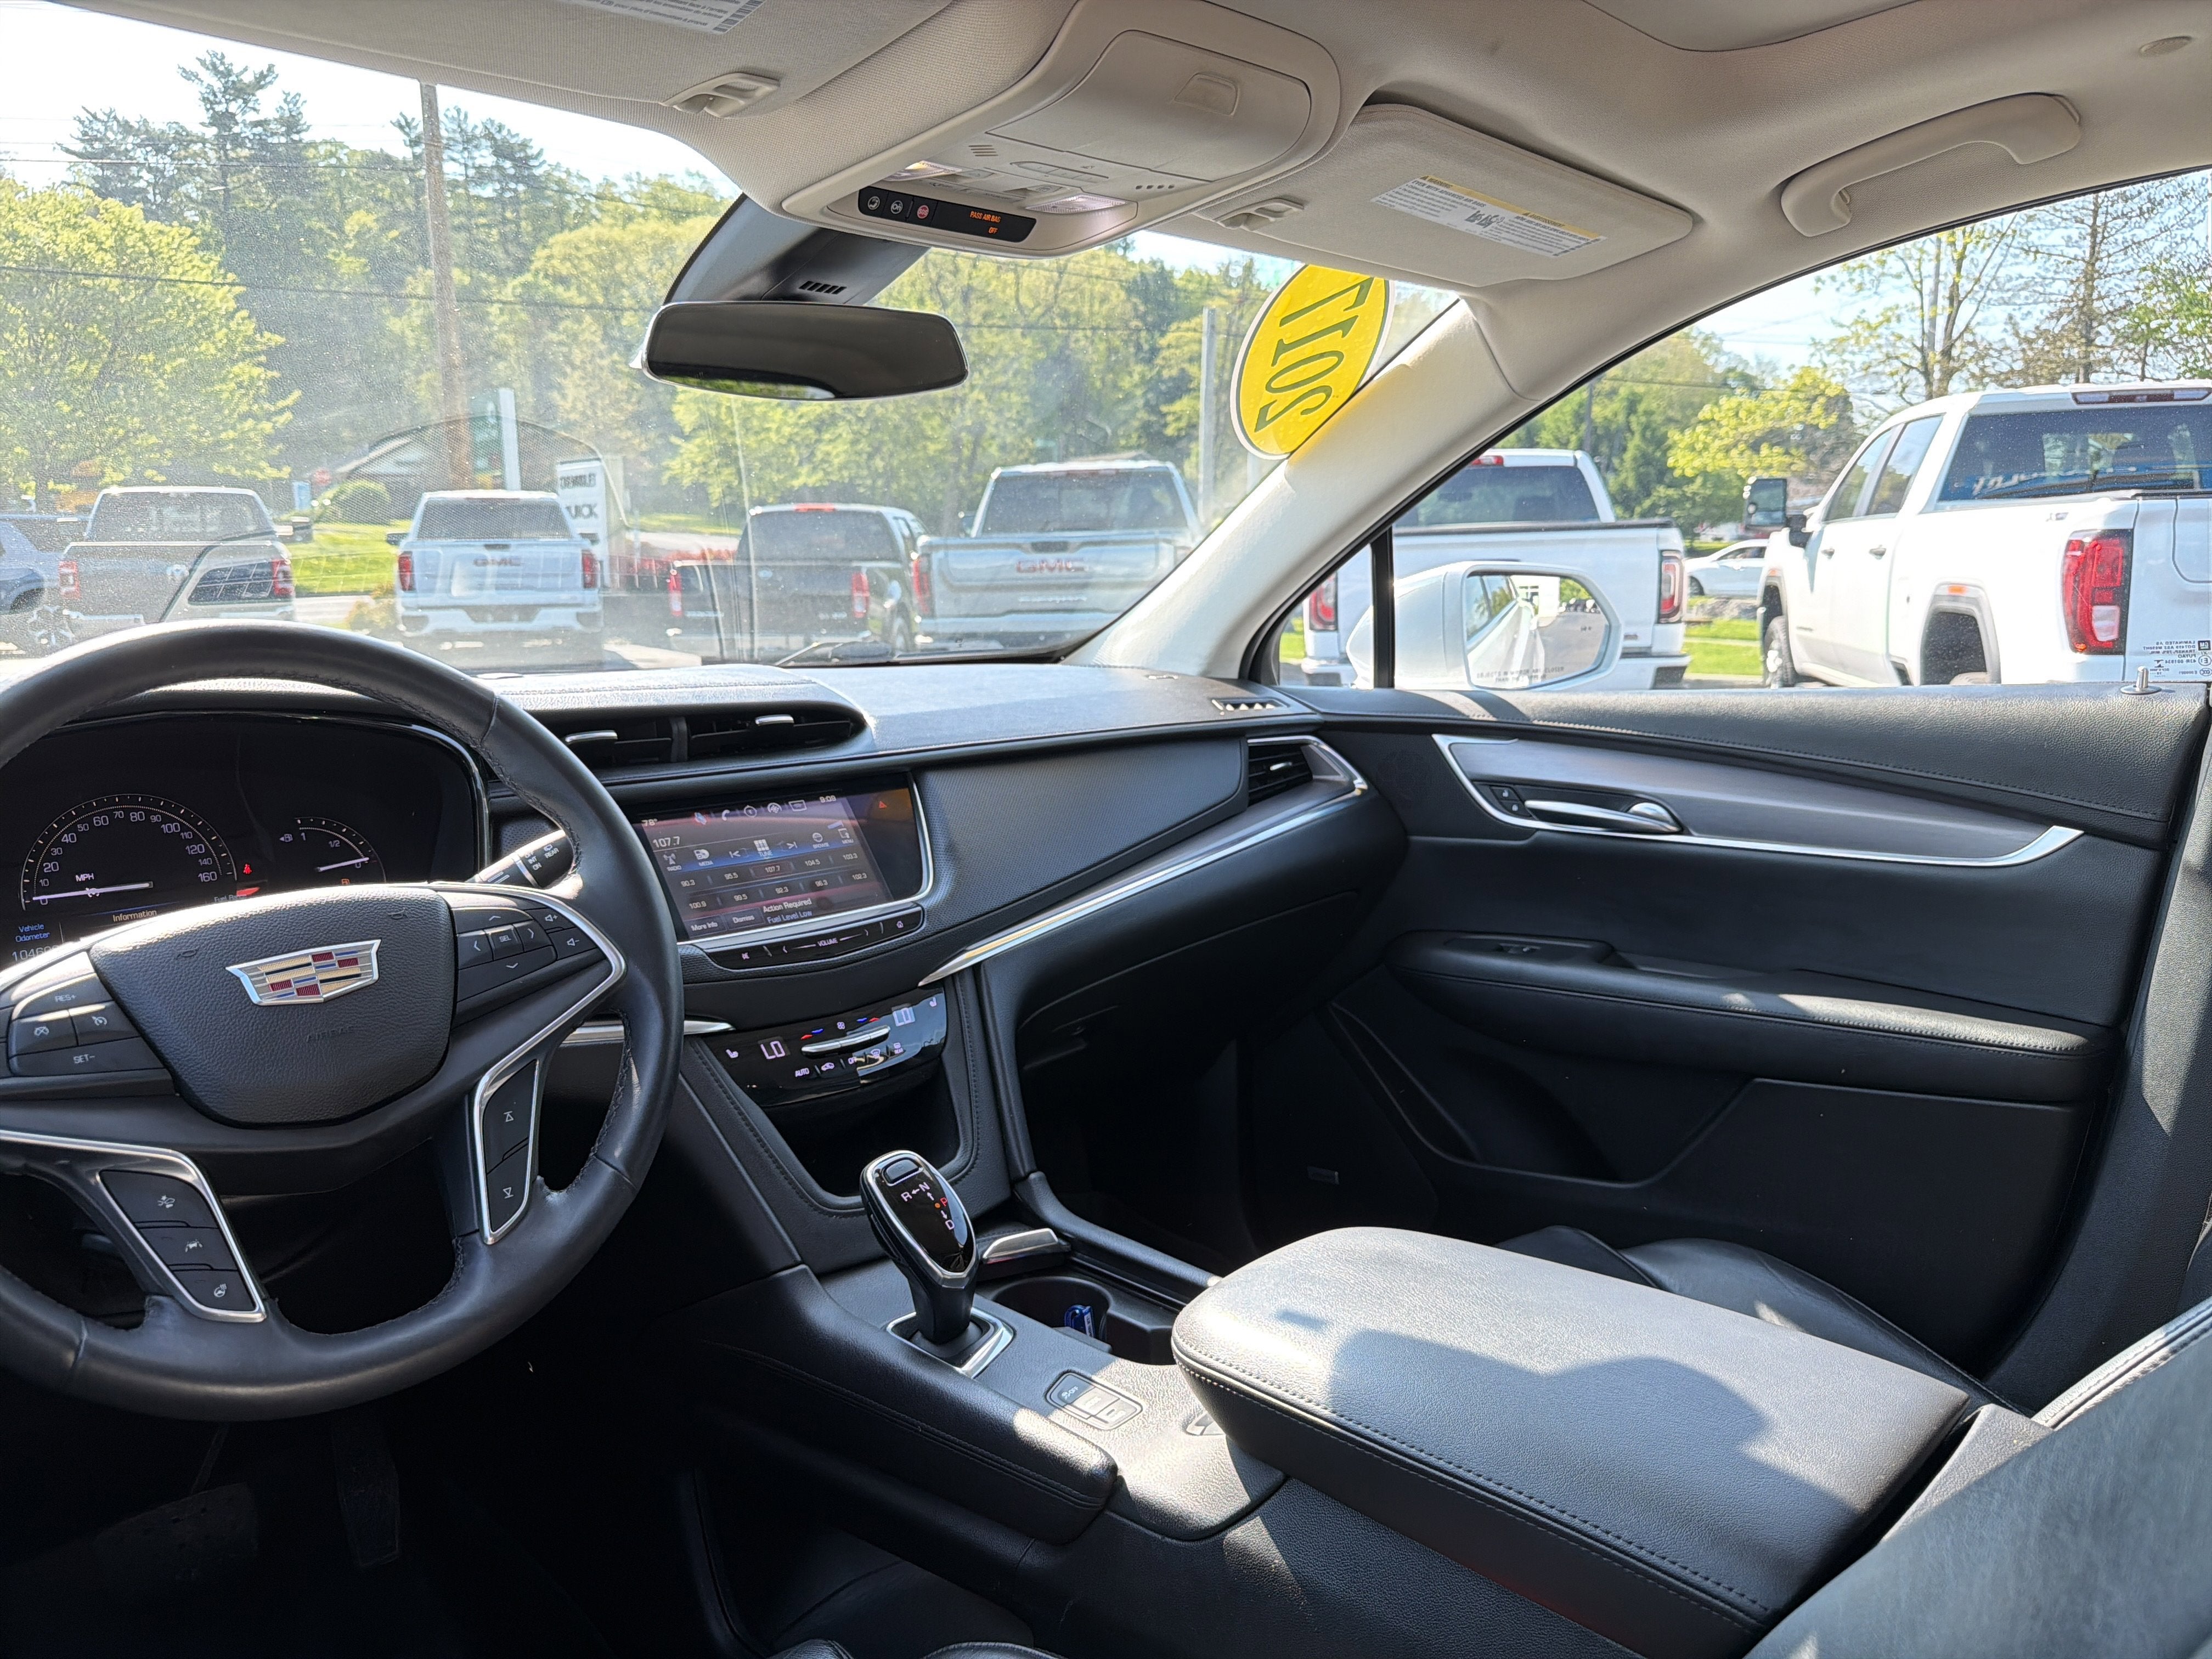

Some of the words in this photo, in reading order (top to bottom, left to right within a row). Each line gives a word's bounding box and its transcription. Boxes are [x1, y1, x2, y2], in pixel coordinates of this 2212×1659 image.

[969, 211, 983, 220] PASS
[565, 503, 599, 520] UICK
[1016, 557, 1087, 573] GMC
[112, 810, 125, 819] 70
[129, 811, 145, 822] 80
[150, 814, 162, 822] 90
[93, 815, 109, 826] 60
[77, 823, 89, 832] 50
[161, 822, 180, 834] 100
[61, 833, 77, 844] 40
[180, 831, 193, 839] 110
[301, 832, 306, 841] 1
[653, 836, 680, 848] 107.7
[50, 847, 63, 856] 30
[185, 844, 205, 855] 120
[545, 848, 560, 859] REAR
[198, 857, 213, 866] 140
[528, 856, 538, 864] INT
[43, 862, 59, 873] 20
[532, 862, 542, 871] ON
[75, 872, 94, 882] MPH
[198, 871, 217, 883] 160
[40, 878, 49, 887] 10
[689, 901, 707, 909] 100.9
[763, 904, 783, 913] Action
[783, 898, 812, 909] Required
[112, 909, 157, 922] Information
[732, 915, 755, 923] Dismiss
[767, 915, 781, 924] Fuel
[783, 912, 799, 921] Level
[19, 924, 44, 933] Vehicle
[15, 933, 50, 943] Odometer
[817, 938, 838, 947] VOLUME
[55, 994, 77, 1002] RES+
[795, 1068, 810, 1077] AUTO
[919, 1182, 930, 1192] N
[901, 1192, 912, 1201] R
[940, 1197, 949, 1207] P
[945, 1220, 955, 1230] D
